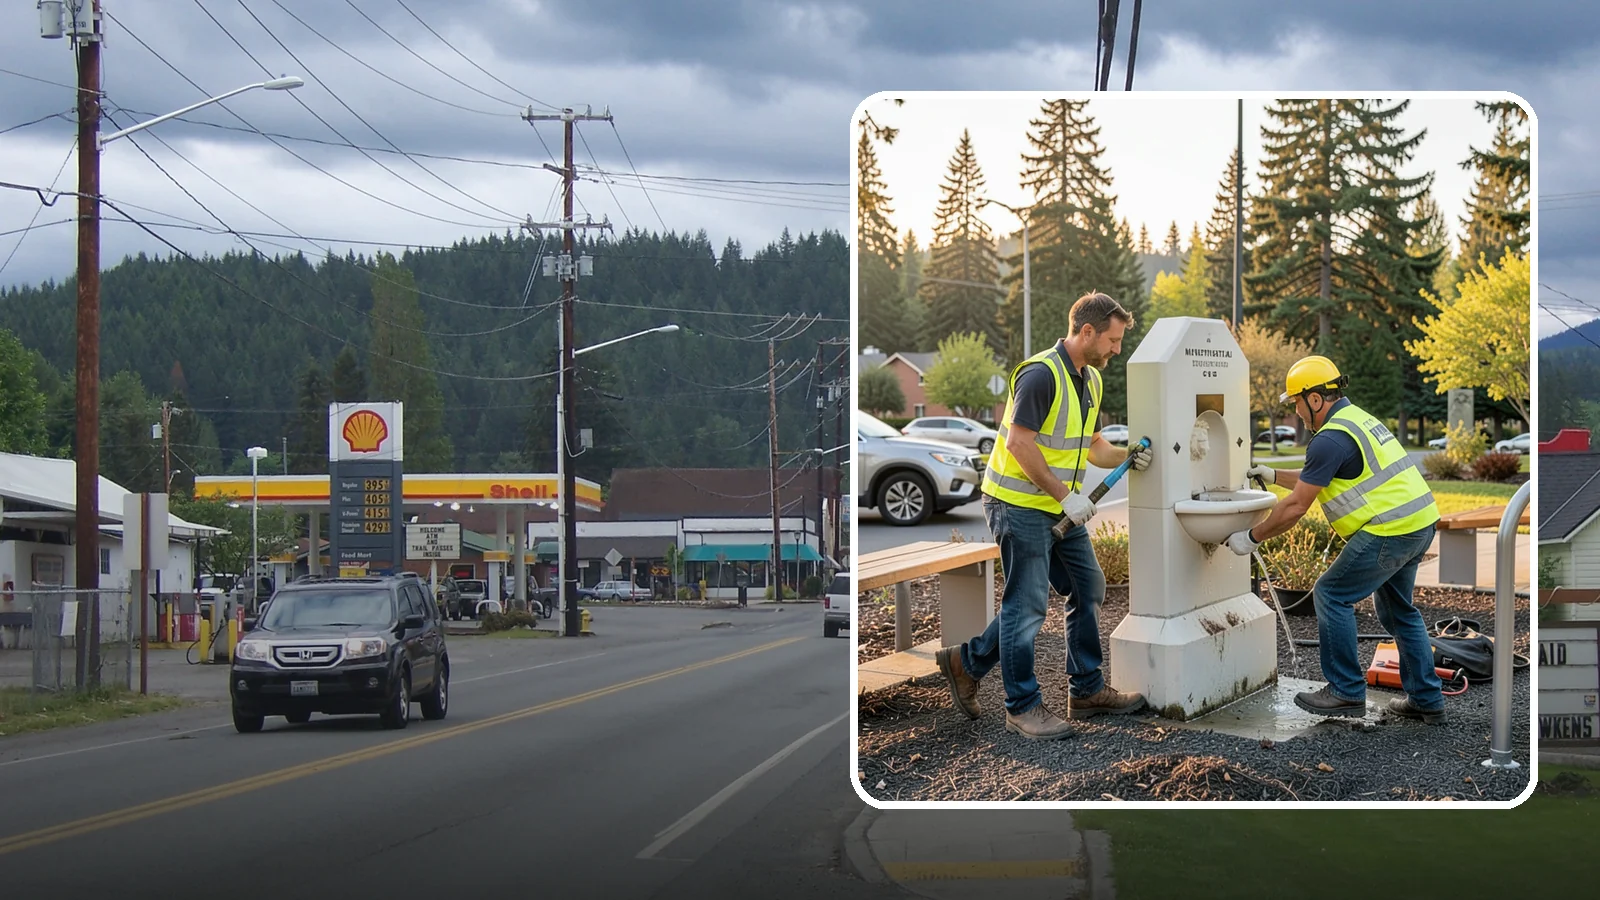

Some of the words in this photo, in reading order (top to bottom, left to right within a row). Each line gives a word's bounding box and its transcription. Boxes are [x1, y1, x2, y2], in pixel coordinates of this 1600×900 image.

[366, 480, 383, 490] 395
[490, 485, 547, 499] Shell
[366, 494, 383, 504] 405
[366, 508, 383, 518] 415
[366, 522, 383, 532] 429
